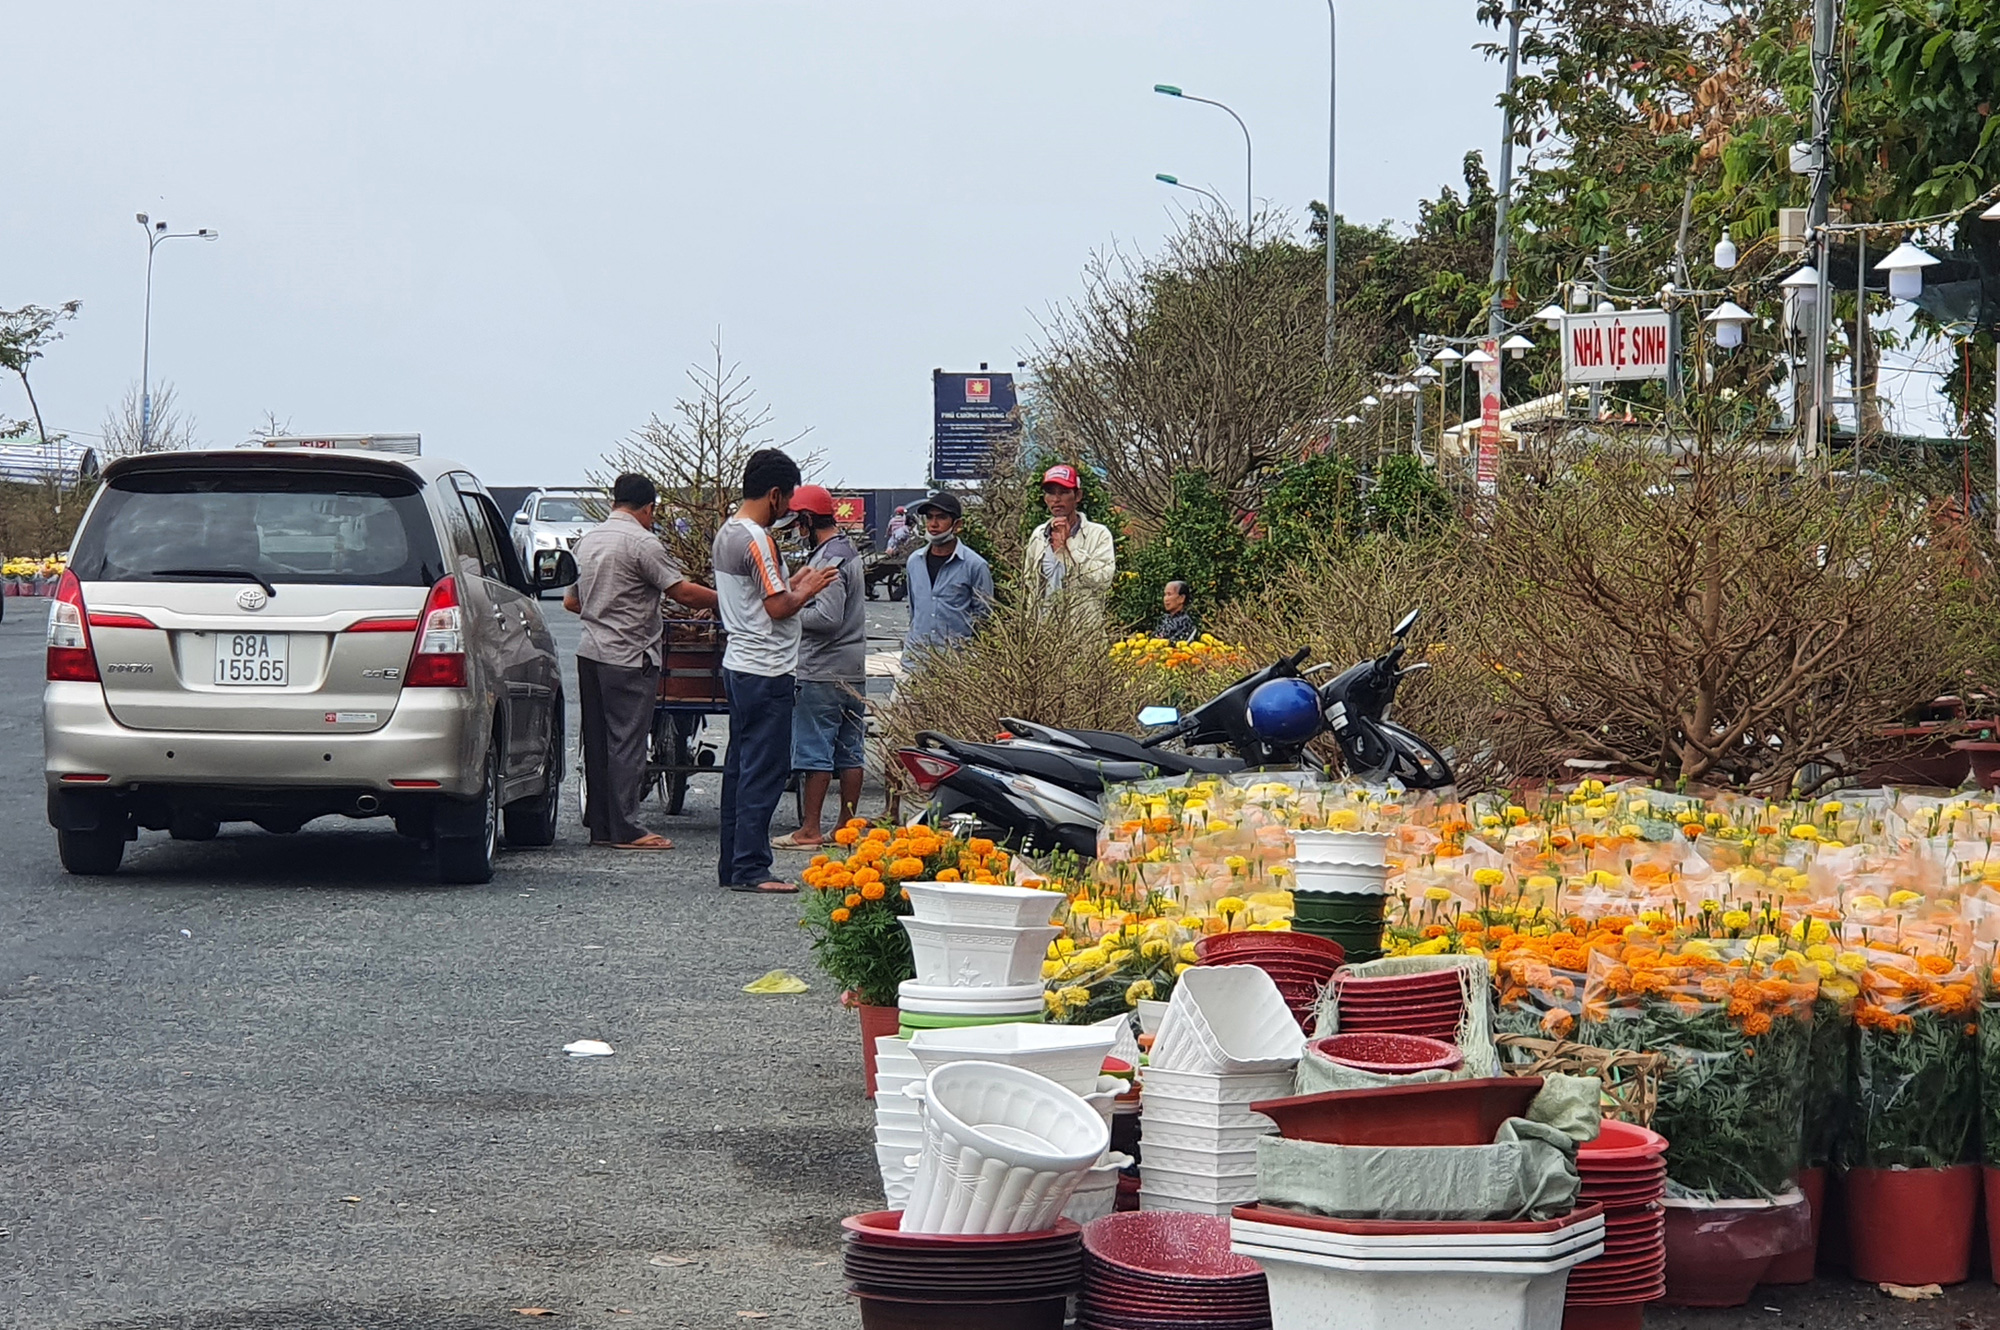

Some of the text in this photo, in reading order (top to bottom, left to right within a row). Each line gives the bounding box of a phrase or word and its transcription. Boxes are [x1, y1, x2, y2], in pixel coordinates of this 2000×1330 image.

[1573, 317, 1665, 371] NHÀ VỆ SINH
[233, 635, 269, 657] 68A
[219, 659, 284, 681] 155.65
